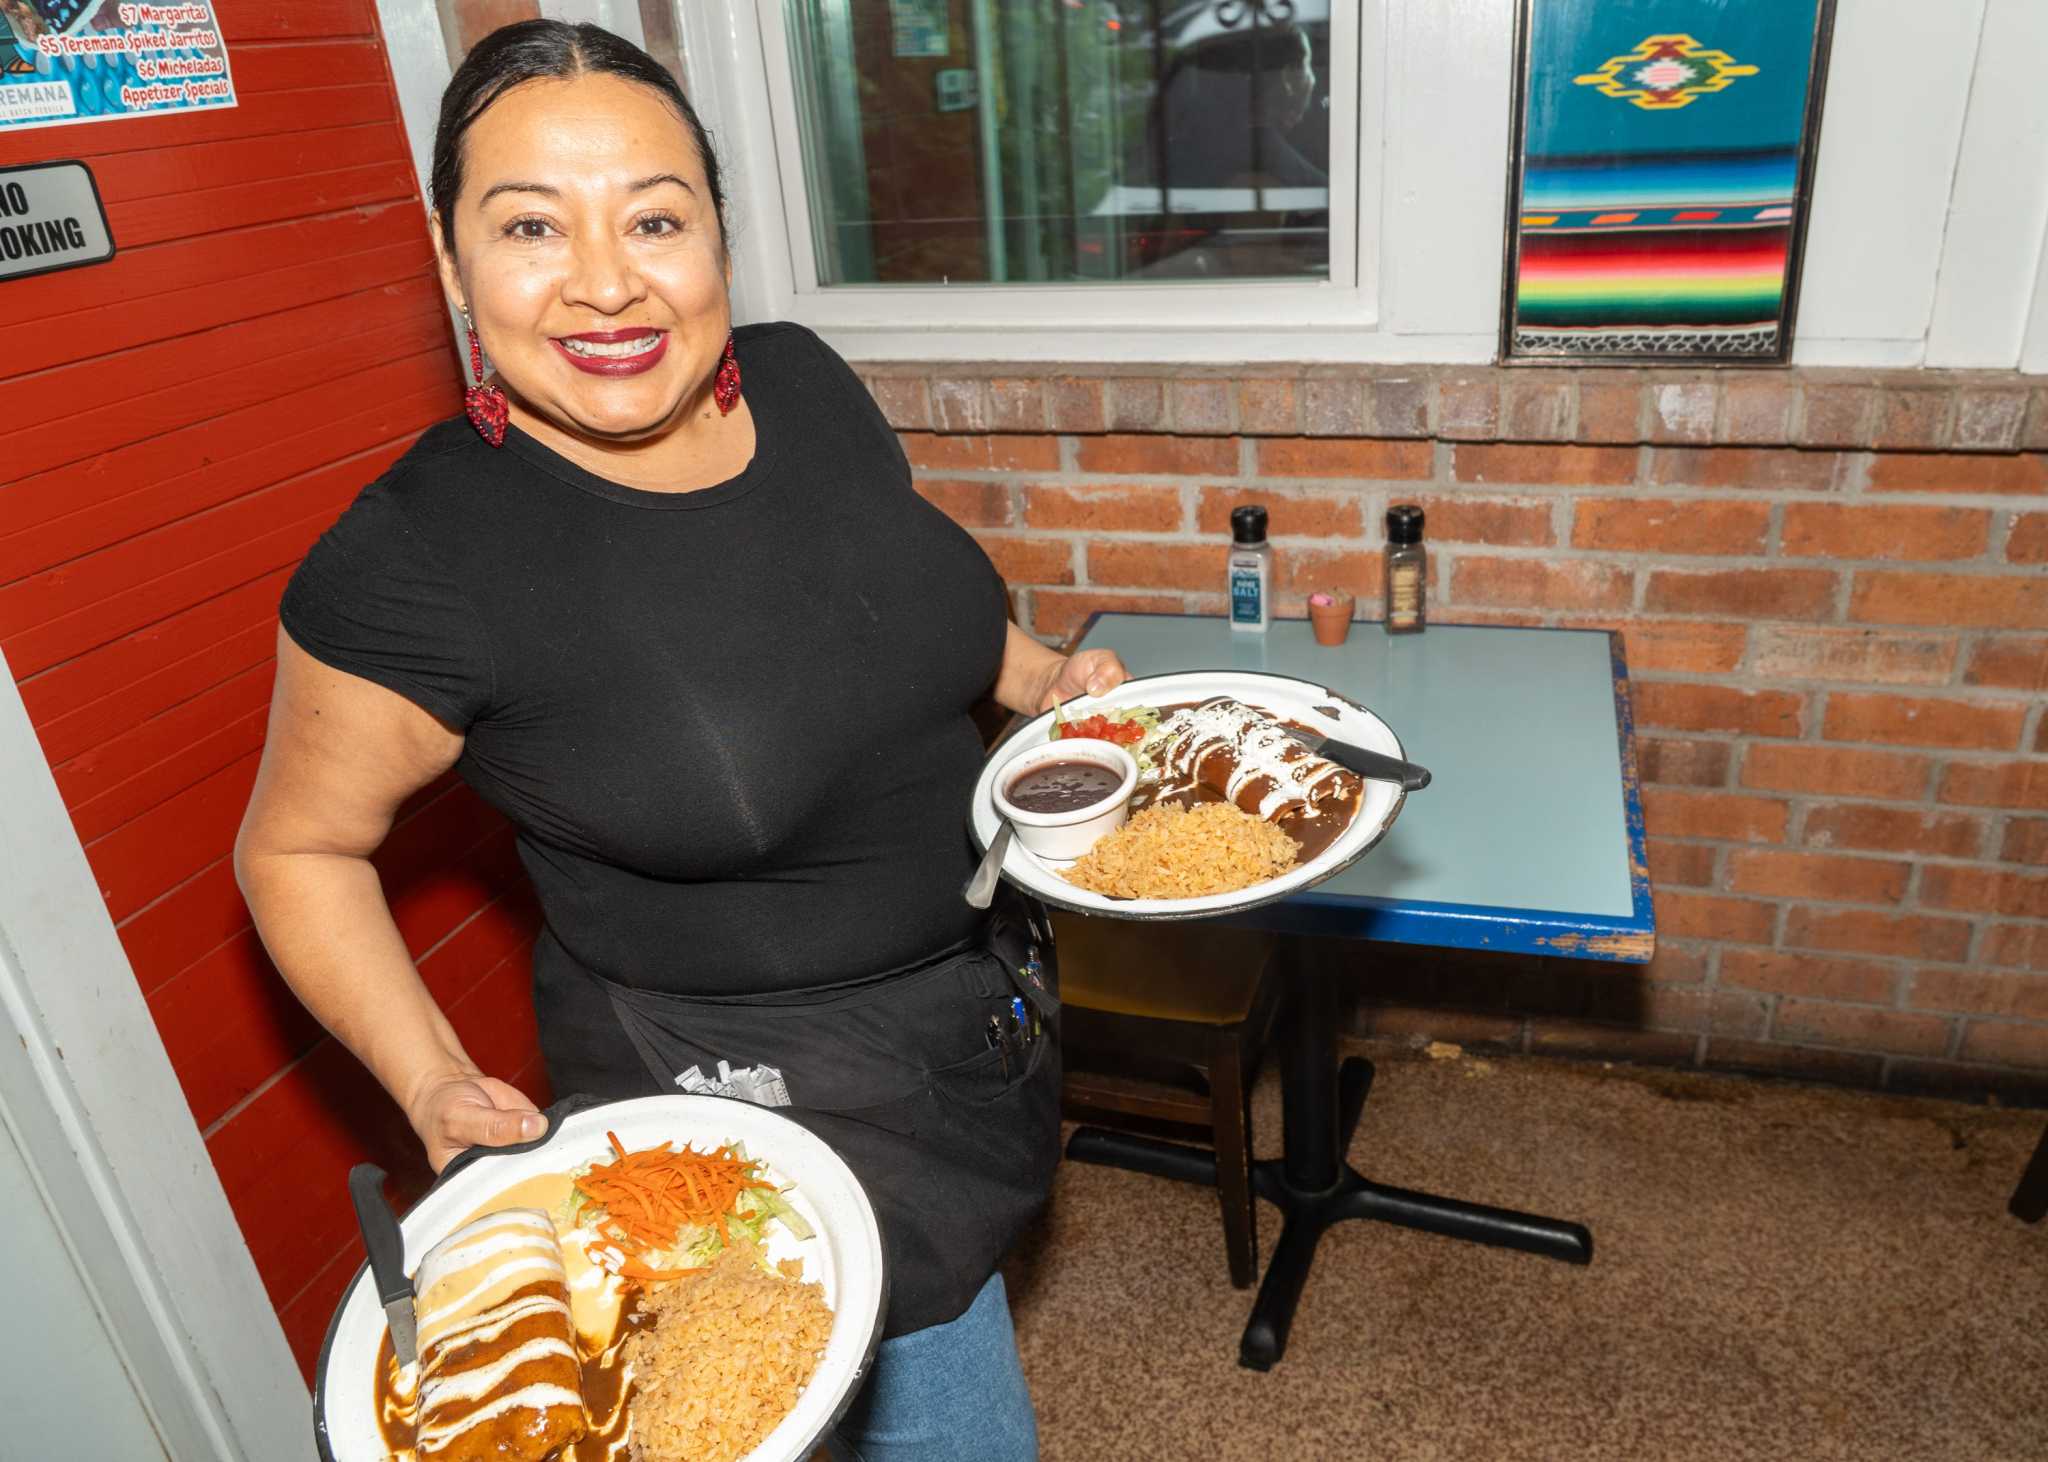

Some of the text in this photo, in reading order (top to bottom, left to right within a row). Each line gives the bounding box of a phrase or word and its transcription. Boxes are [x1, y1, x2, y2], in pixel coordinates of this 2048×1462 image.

[121, 5, 207, 26] $7 Margaritas
[40, 31, 215, 54] $5 Teremana Spiked Jarritos
[139, 58, 222, 77] $6 Micheladas
[122, 80, 229, 106] Appetizer Specials
[0, 217, 87, 261] OKING
